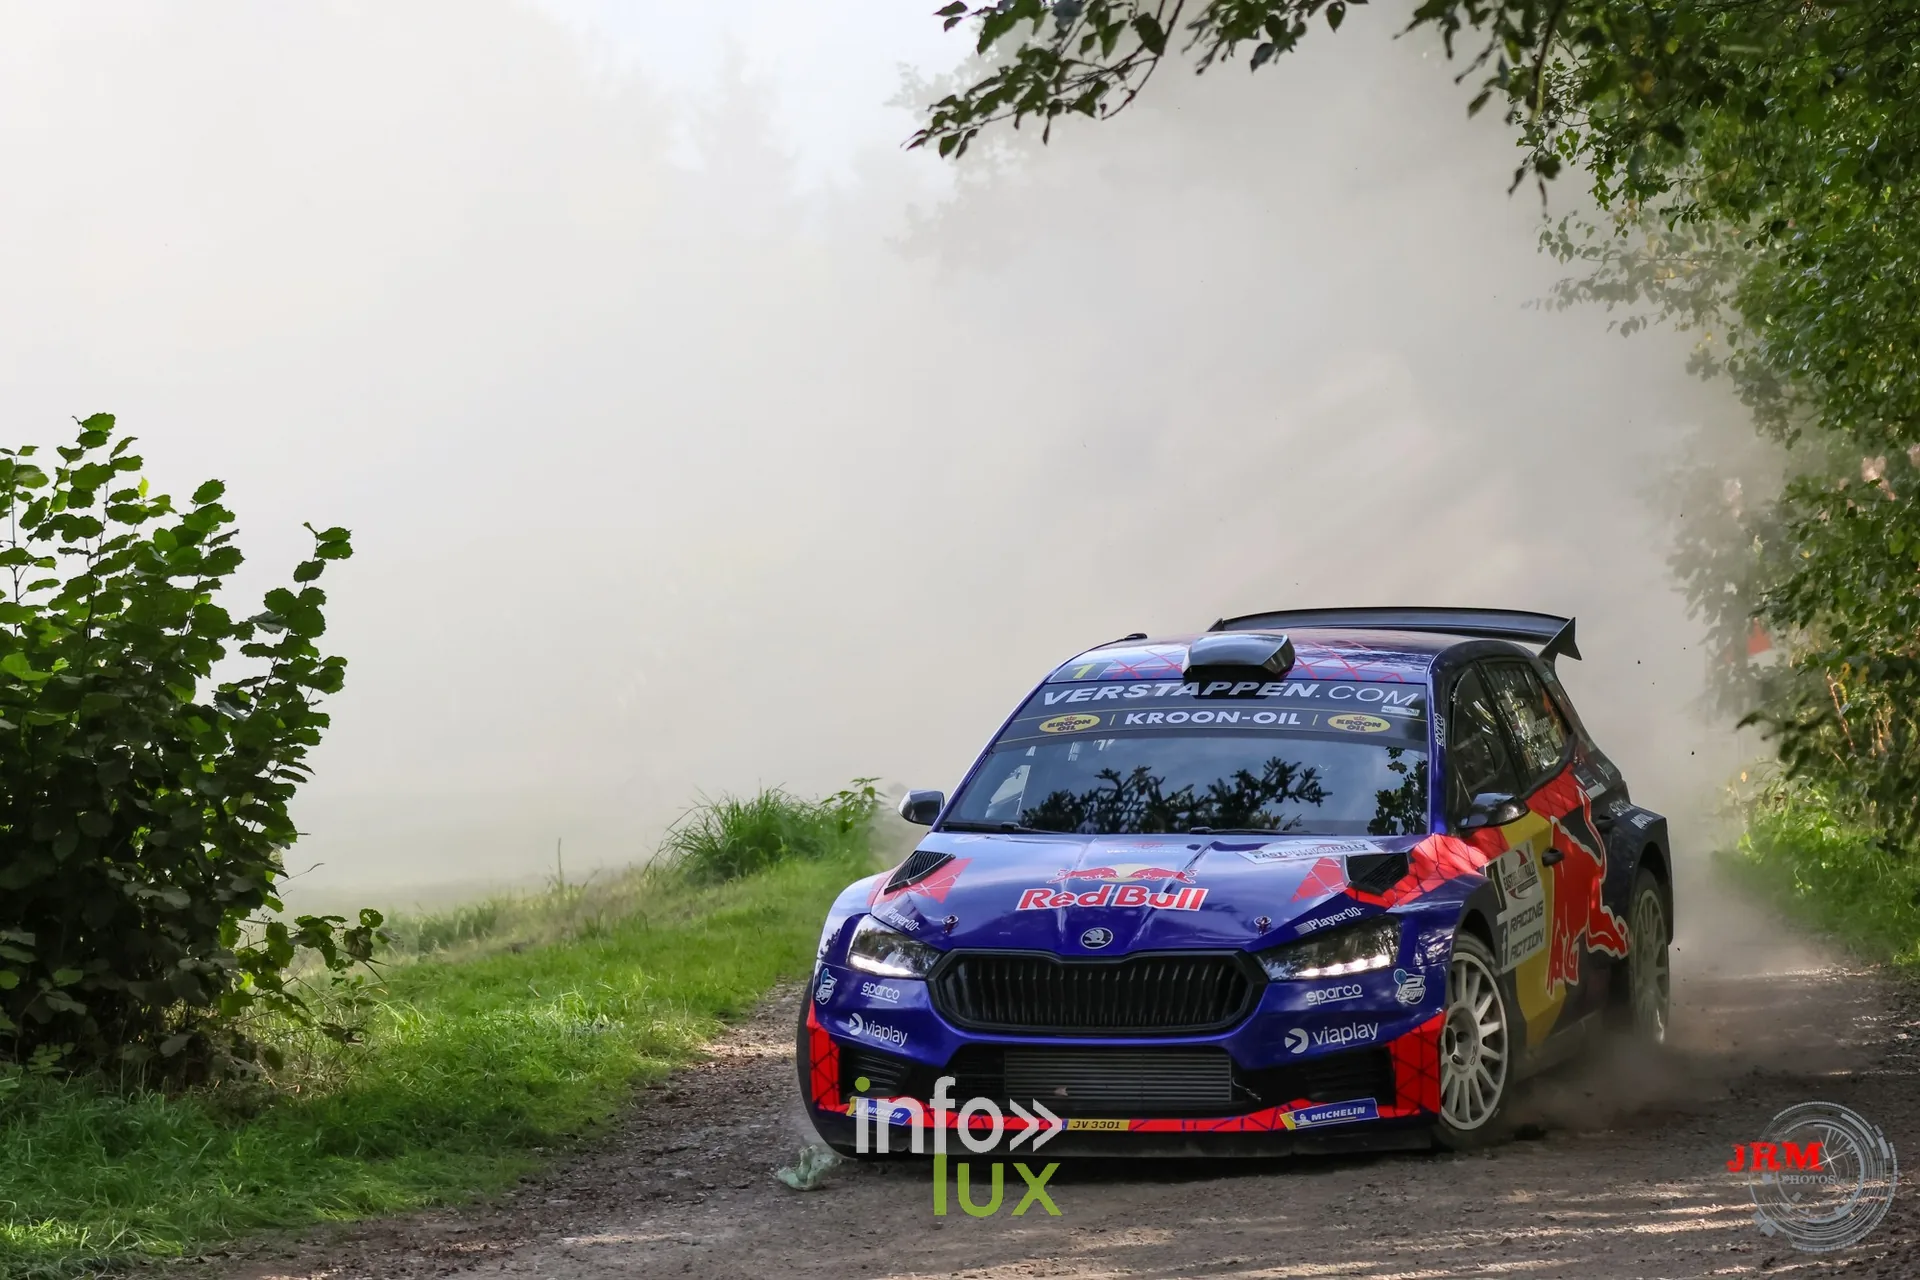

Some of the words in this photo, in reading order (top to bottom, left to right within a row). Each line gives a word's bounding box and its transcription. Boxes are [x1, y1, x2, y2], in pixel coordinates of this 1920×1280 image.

[1073, 663, 1096, 679] 1
[1044, 681, 1419, 706] VERSTAPPEN.COM
[1047, 717, 1092, 728] KROON
[1124, 711, 1301, 725] KROON-OIL
[1335, 718, 1382, 728] KROON
[1346, 724, 1367, 732] OIL
[862, 982, 900, 1000] sparco
[1306, 984, 1362, 1005] sparco
[865, 1020, 908, 1047] viaplay
[1312, 1022, 1379, 1045] viaplay
[1311, 1106, 1366, 1121] MICHELIN
[1072, 1120, 1088, 1129] JV
[1091, 1120, 1120, 1129] 3301
